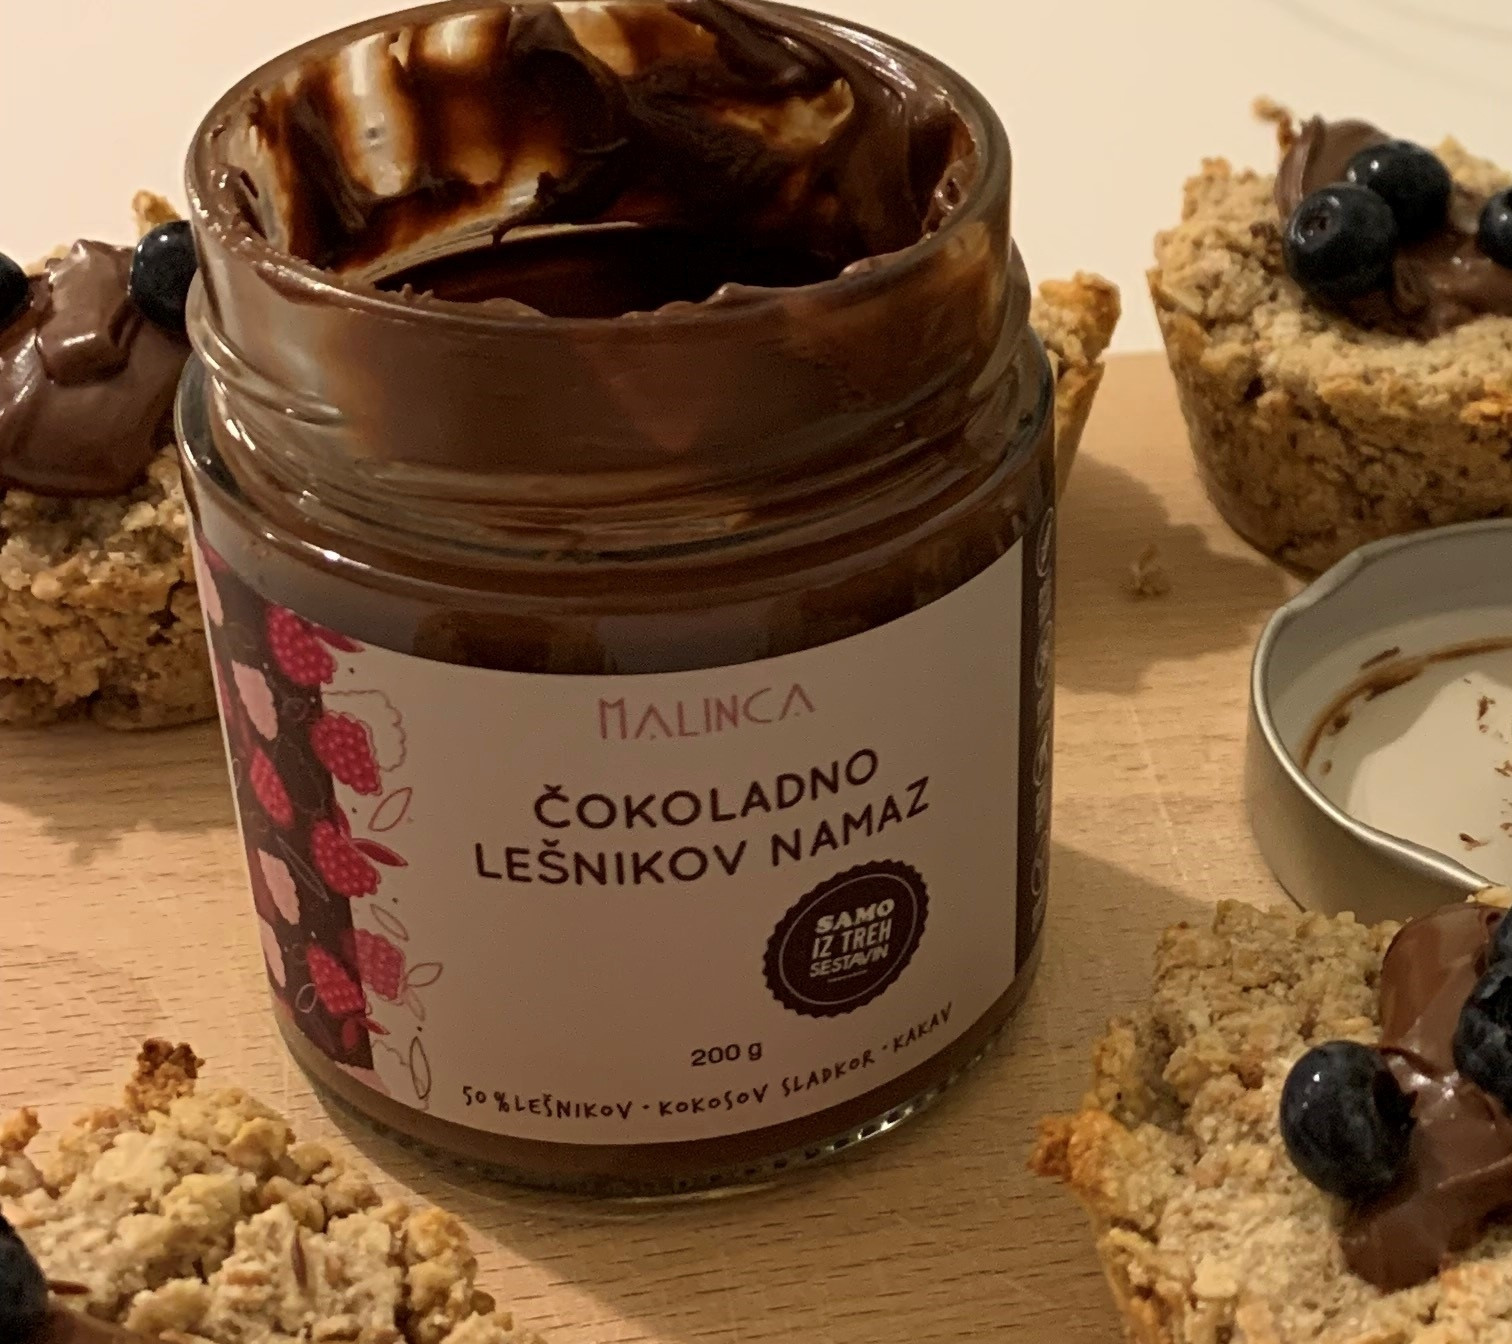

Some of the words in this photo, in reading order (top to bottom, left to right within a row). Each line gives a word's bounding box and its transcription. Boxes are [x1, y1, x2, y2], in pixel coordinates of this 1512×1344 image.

[599, 683, 816, 740] MALINCA
[533, 748, 878, 829] ČOKOLADNO
[474, 838, 747, 886] LEŠNIKOV
[770, 776, 930, 867] NAMAZ
[812, 935, 834, 960] IZ
[841, 918, 893, 954] TREH
[815, 898, 896, 934] SAMO
[809, 944, 889, 978] SESTAVIN
[659, 1084, 769, 1117] KOKOSOV
[781, 1049, 876, 1097] SLADKOR
[893, 1001, 952, 1053] KAKAV
[690, 1043, 741, 1068] 200
[747, 1041, 762, 1062] g
